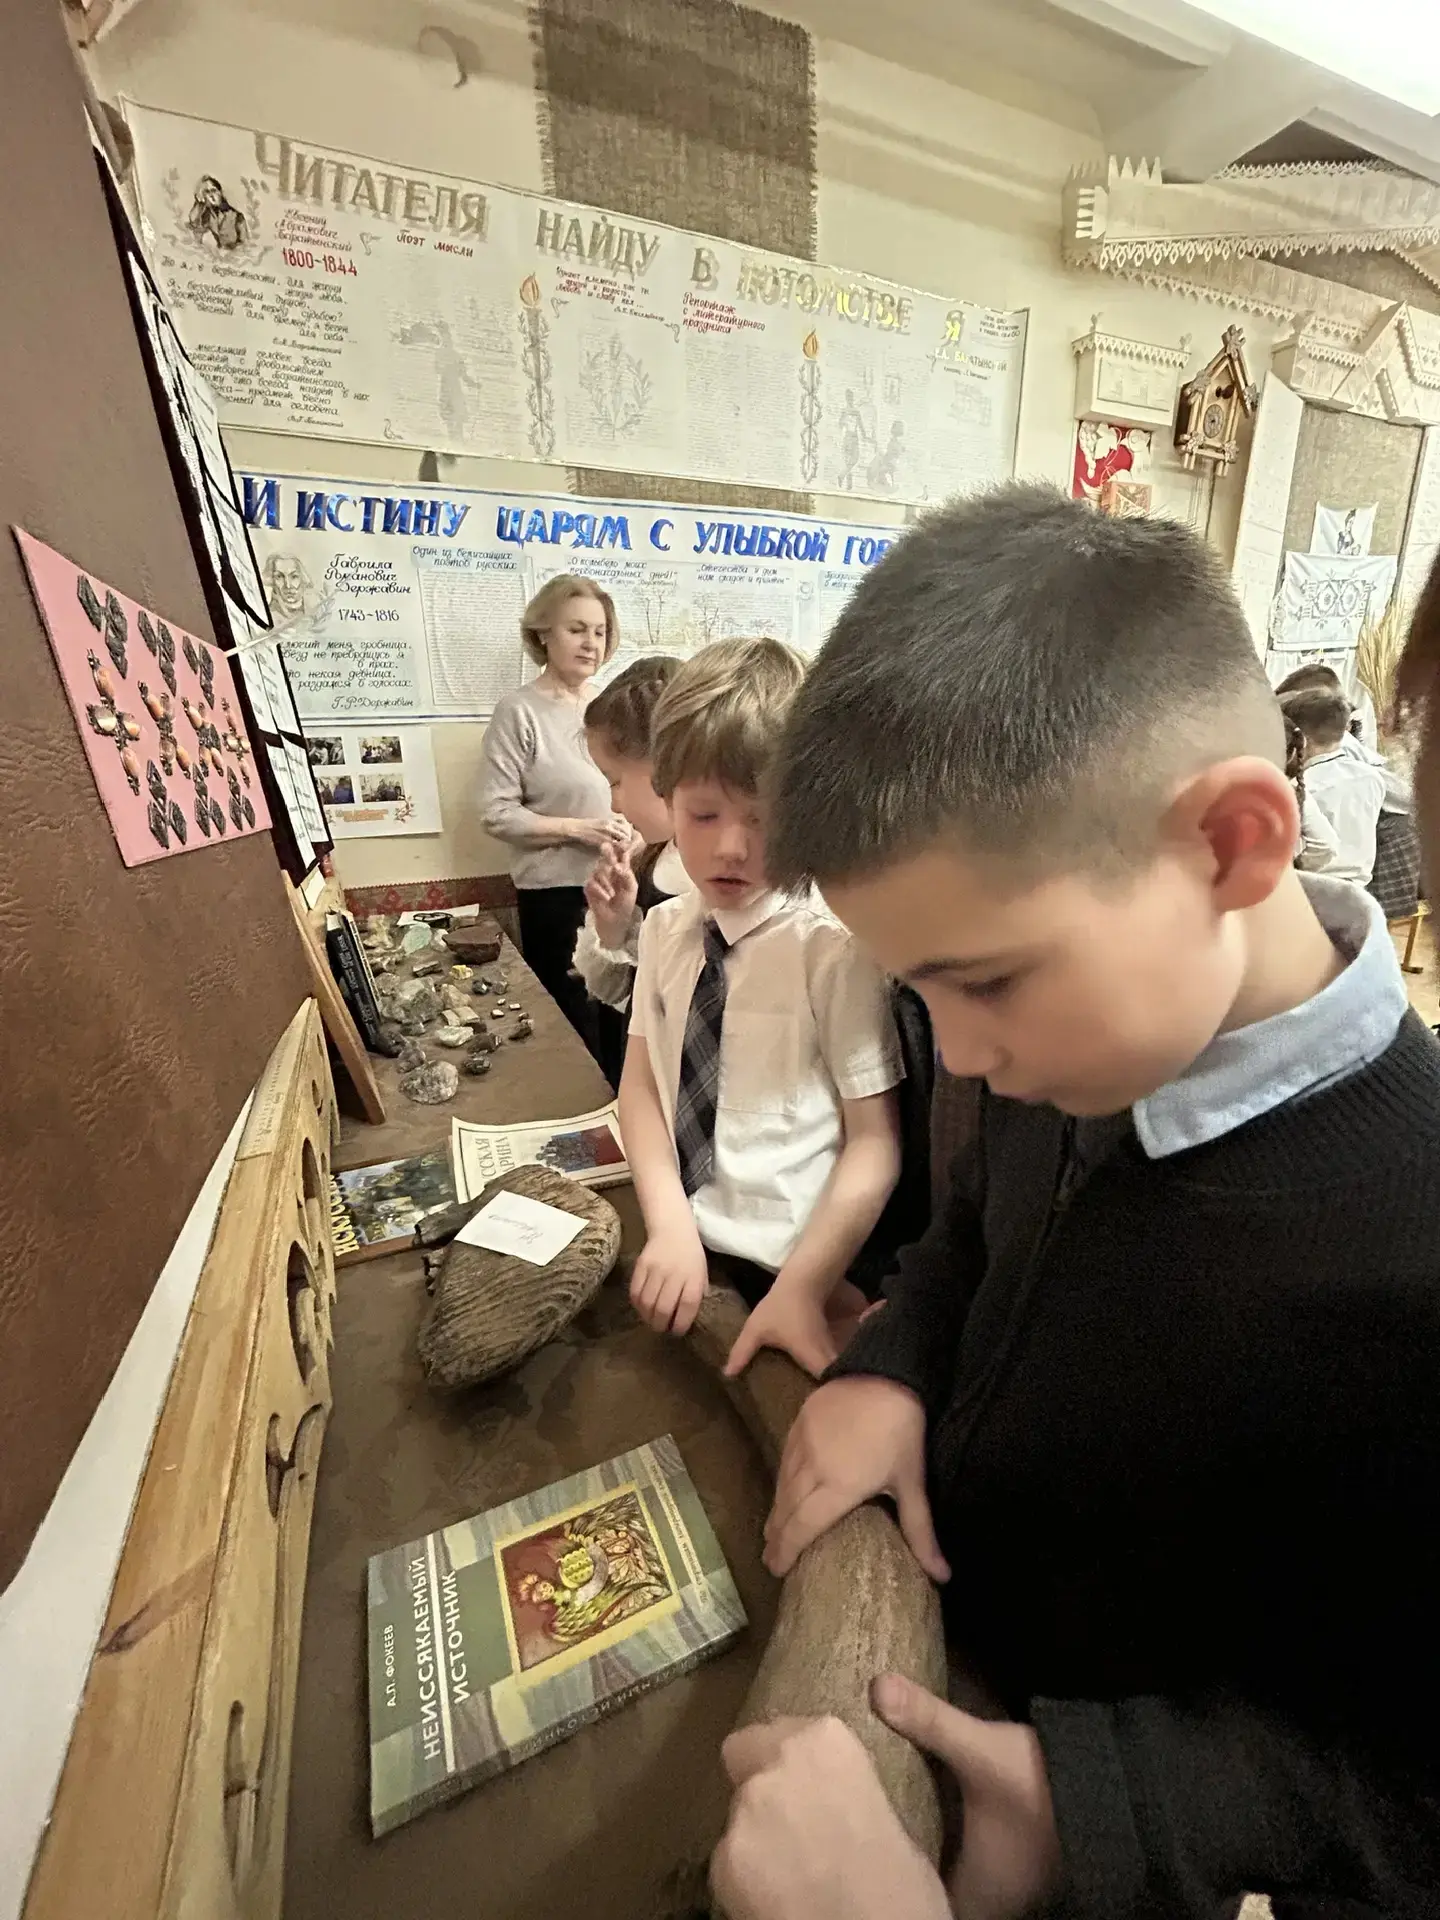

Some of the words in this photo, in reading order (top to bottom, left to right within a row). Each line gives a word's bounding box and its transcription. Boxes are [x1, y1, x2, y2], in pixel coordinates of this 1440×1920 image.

[397, 229, 426, 246] Поэт
[433, 241, 474, 257] мысли
[535, 208, 660, 283] НАЙДУ
[690, 248, 720, 291] В
[281, 247, 358, 276] 1800-1844
[682, 291, 737, 315] Репортаж
[682, 317, 731, 334] праздника
[693, 309, 766, 331] литературного
[242, 477, 282, 530] И
[296, 490, 471, 537] ИСТИНУ
[496, 506, 632, 550] ЦАРЯМ
[649, 518, 674, 551] С
[693, 521, 830, 562] УЛЫБКОЙ
[842, 535, 896, 567] ГОВ
[330, 553, 392, 572] Гаврила
[412, 546, 437, 558] Один
[442, 548, 452, 558] из
[325, 567, 397, 581] Романович
[433, 558, 470, 568] поэтов
[476, 561, 517, 571] русских
[335, 581, 411, 598] Державин
[314, 651, 327, 659] не
[331, 649, 390, 661] превращусь
[327, 641, 353, 650] меня
[308, 670, 341, 678] некая
[475, 1138, 496, 1177] ССКАЯ
[442, 1570, 470, 1704] ИСТОЧНИК
[384, 1624, 396, 1677] ФОКЕЕВ
[409, 1556, 441, 1760] НЕИССЯКАЕМЫЙ
